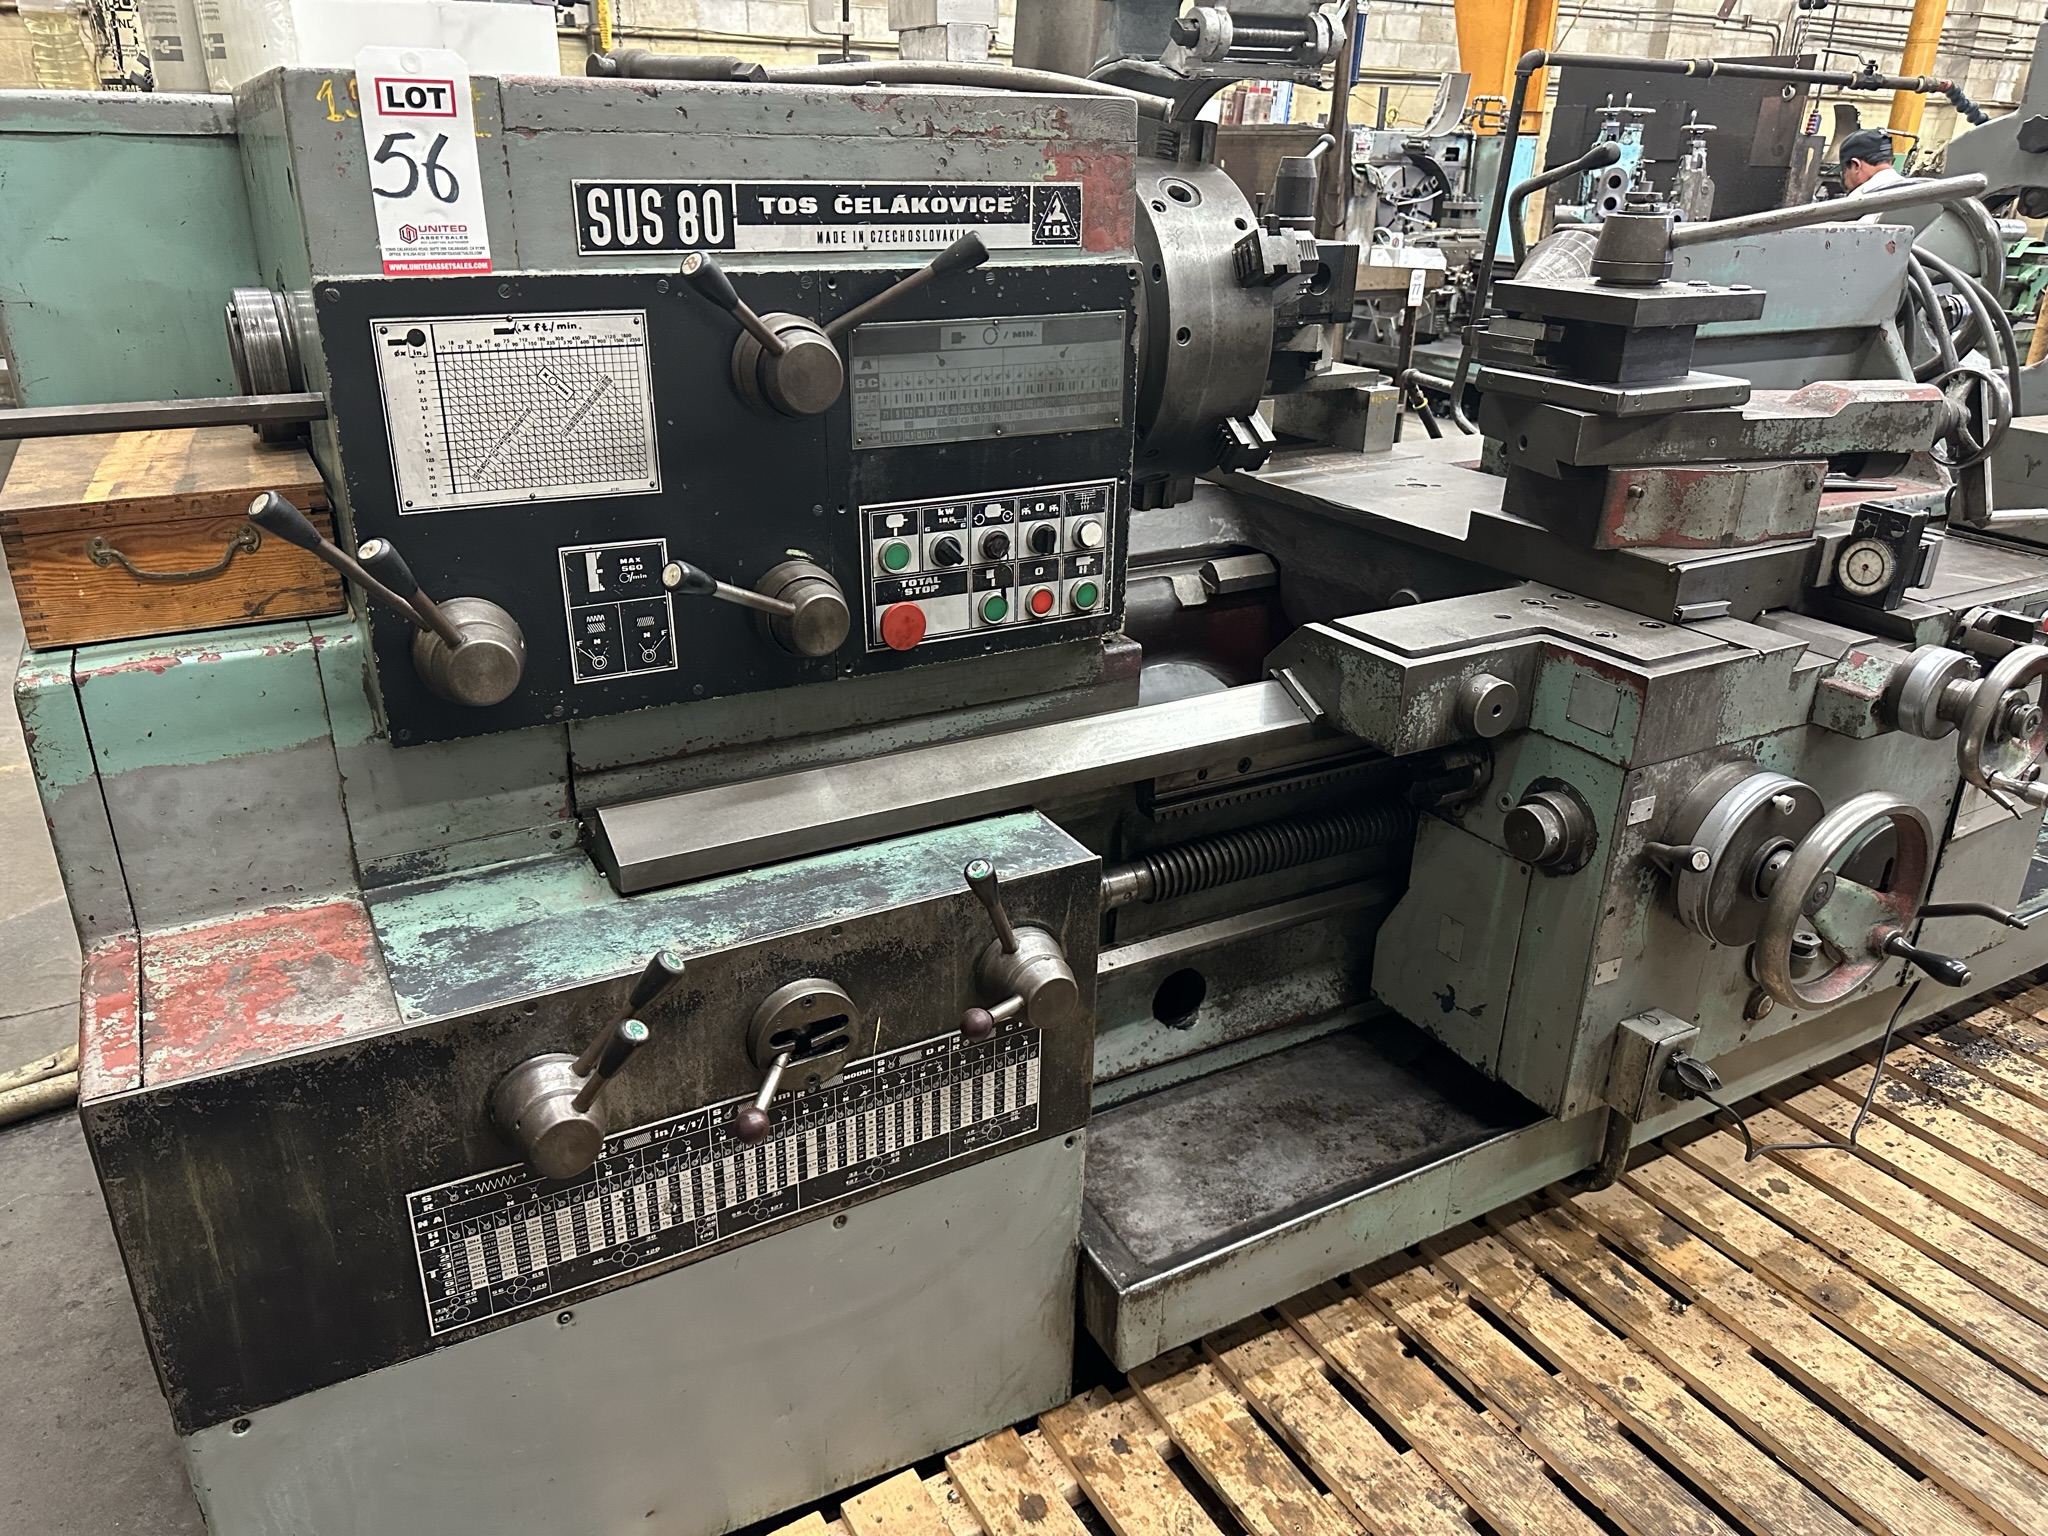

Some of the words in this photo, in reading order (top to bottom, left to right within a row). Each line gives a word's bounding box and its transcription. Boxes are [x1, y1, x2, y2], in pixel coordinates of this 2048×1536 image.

[386, 86, 446, 110] LOT
[373, 132, 459, 203] 56
[758, 196, 818, 214] TOS
[834, 194, 1013, 214] ČELÁKOVICE
[587, 188, 664, 246] SUS
[677, 189, 725, 245] 80
[418, 225, 467, 233] UNITED
[1042, 225, 1070, 236] TOS
[817, 231, 846, 244] MADE
[853, 231, 864, 243] IN
[388, 262, 488, 271] WWW.UNITEDASSETSALES.COM
[1012, 330, 1036, 338] MIN.
[861, 361, 872, 370] A
[900, 576, 941, 587] TOTAL
[904, 585, 940, 596] STOP
[844, 1068, 873, 1080] MODUL
[773, 1092, 790, 1102] m
[418, 1220, 428, 1228] N
[433, 1216, 442, 1224] A
[428, 1231, 438, 1240] H
[430, 1239, 440, 1247] P
[426, 1269, 439, 1278] T
